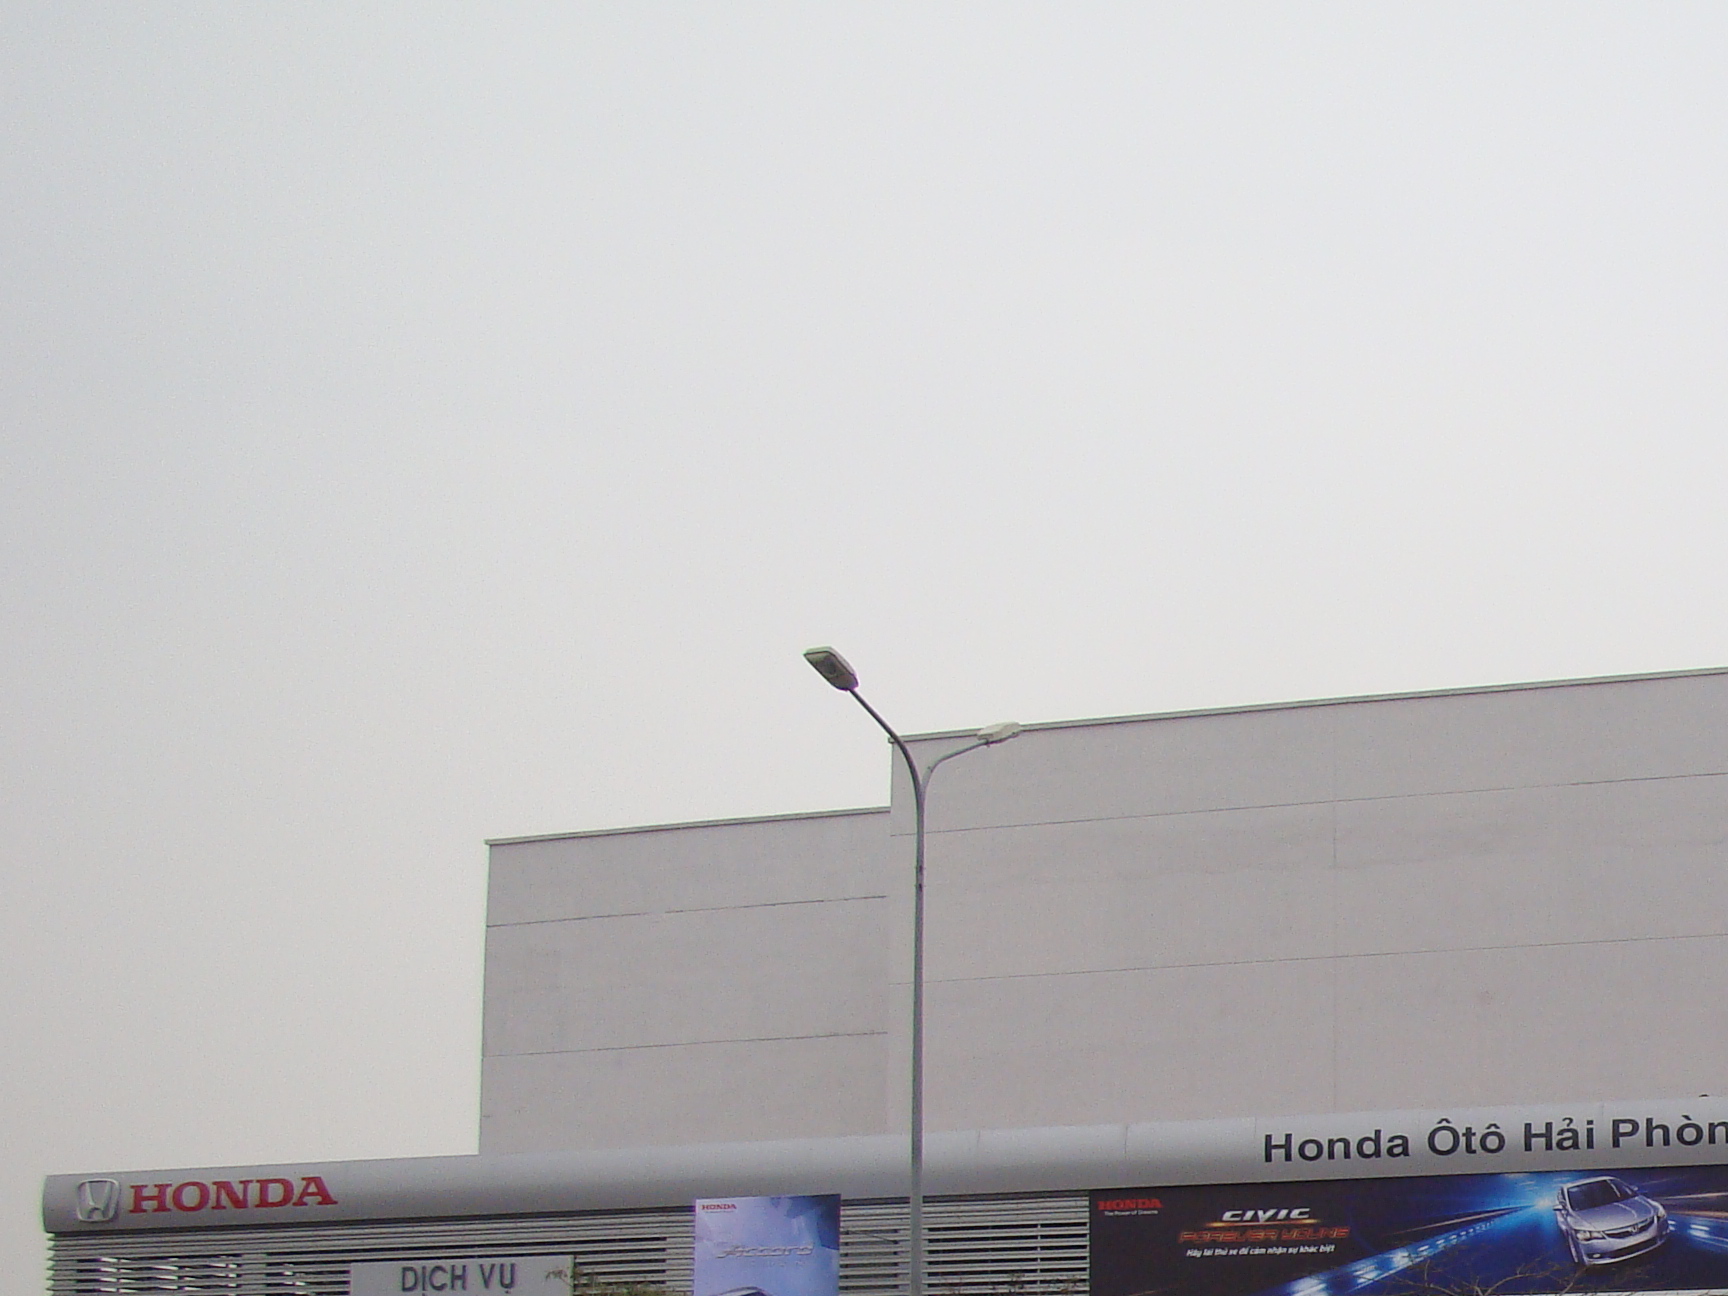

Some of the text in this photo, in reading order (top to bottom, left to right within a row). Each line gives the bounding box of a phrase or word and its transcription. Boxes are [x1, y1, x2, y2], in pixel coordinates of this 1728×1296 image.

[1263, 1129, 1411, 1163] Honda
[1426, 1117, 1506, 1156] Ôtô
[1522, 1116, 1596, 1152] Hải
[129, 1176, 338, 1214] HONDA
[701, 1203, 737, 1211] HONDA
[1097, 1198, 1163, 1210] HONDA
[1222, 1207, 1312, 1222] CIVIC
[401, 1262, 517, 1296] DỊCH VỤ
